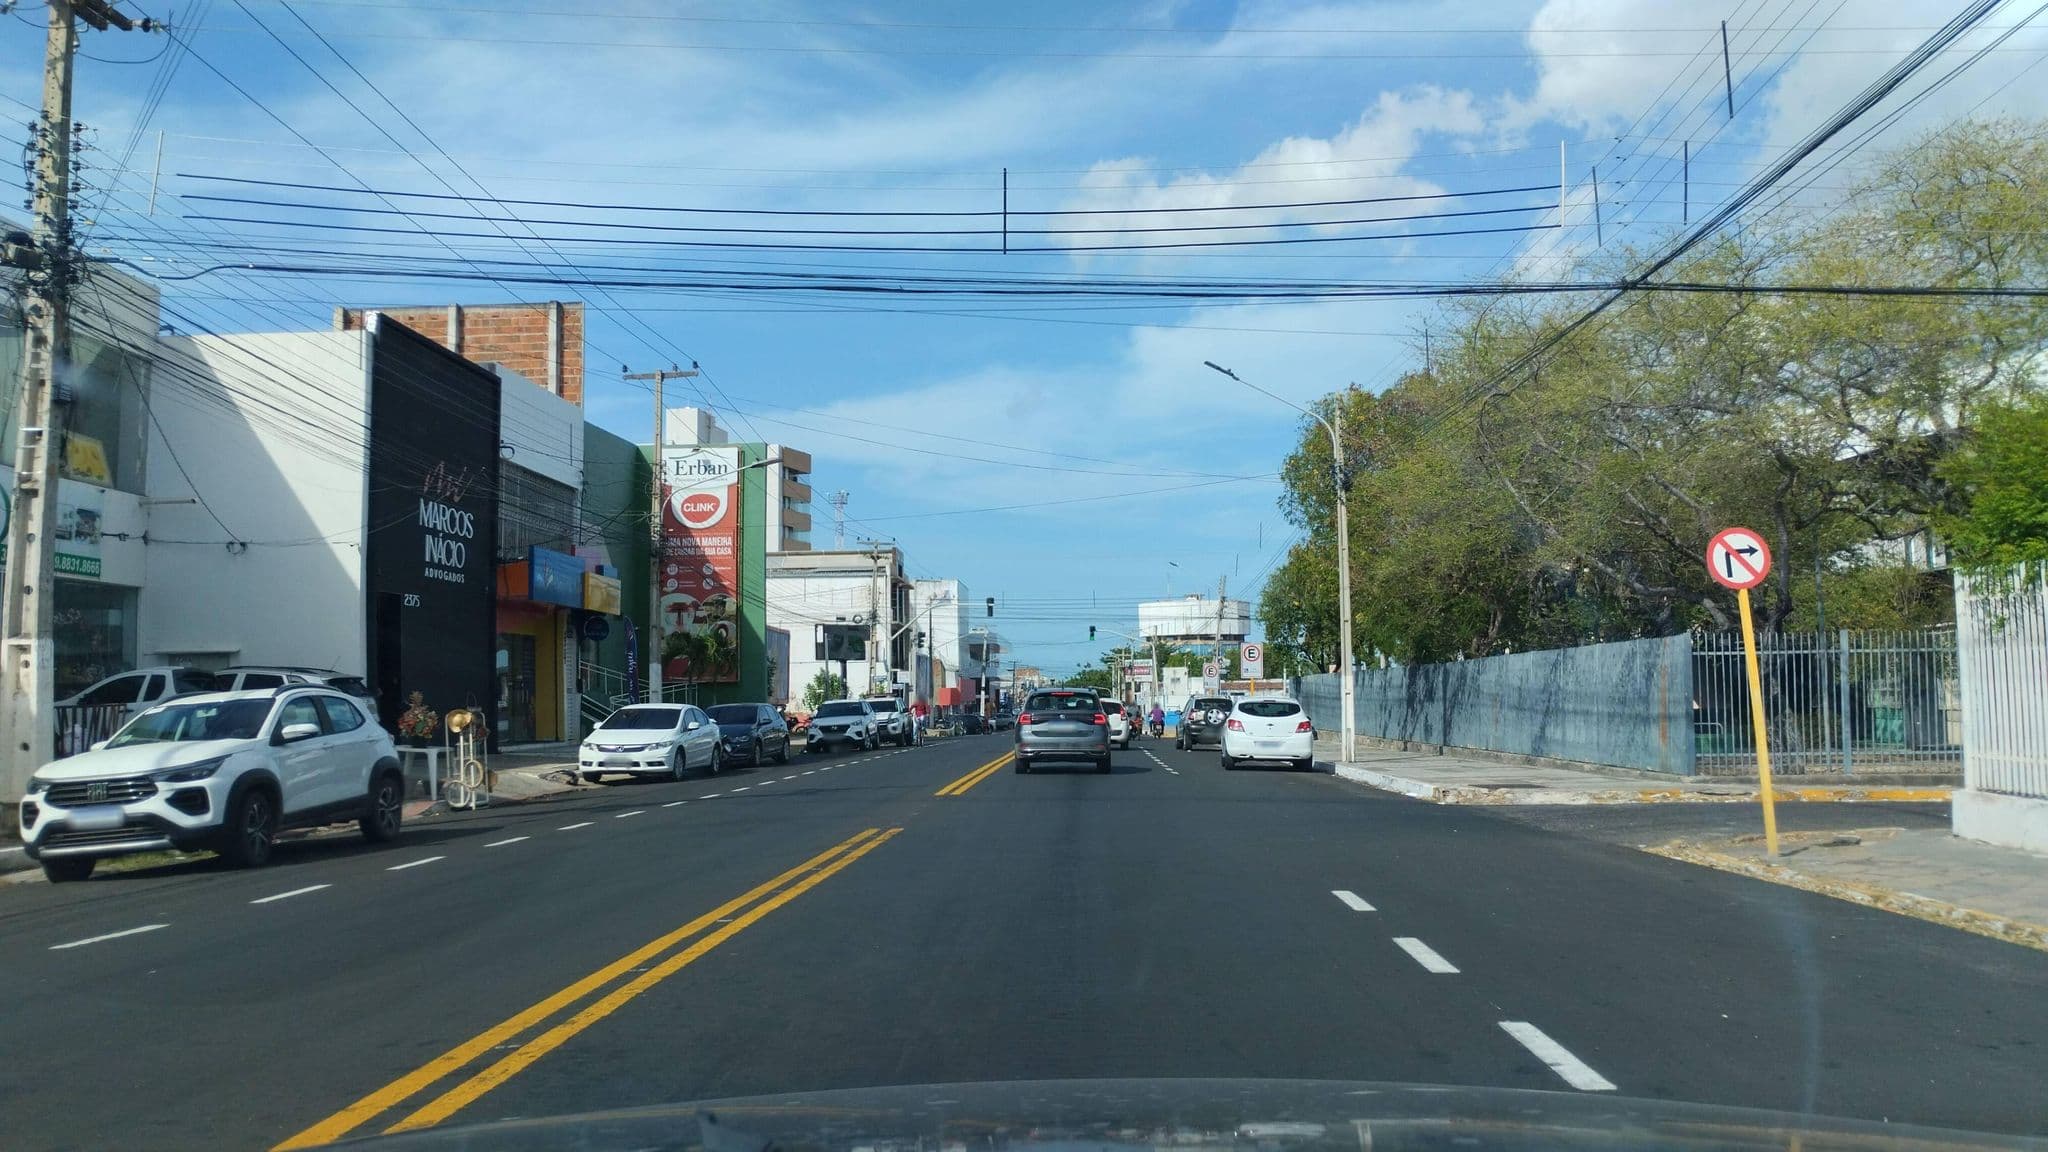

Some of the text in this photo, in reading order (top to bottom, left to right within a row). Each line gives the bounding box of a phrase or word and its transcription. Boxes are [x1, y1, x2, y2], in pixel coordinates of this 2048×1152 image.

[675, 459, 728, 476] Erban
[683, 502, 715, 512] CLINK
[419, 498, 474, 539] MARCOS
[682, 536, 700, 546] NOVA
[701, 536, 732, 546] MANEIRA
[425, 533, 466, 568] INÁCIO
[705, 547, 716, 555] SUA
[717, 546, 732, 555] CASA
[425, 568, 464, 583] ADVOGADOS
[404, 593, 420, 607] 2375
[1248, 648, 1256, 658] E
